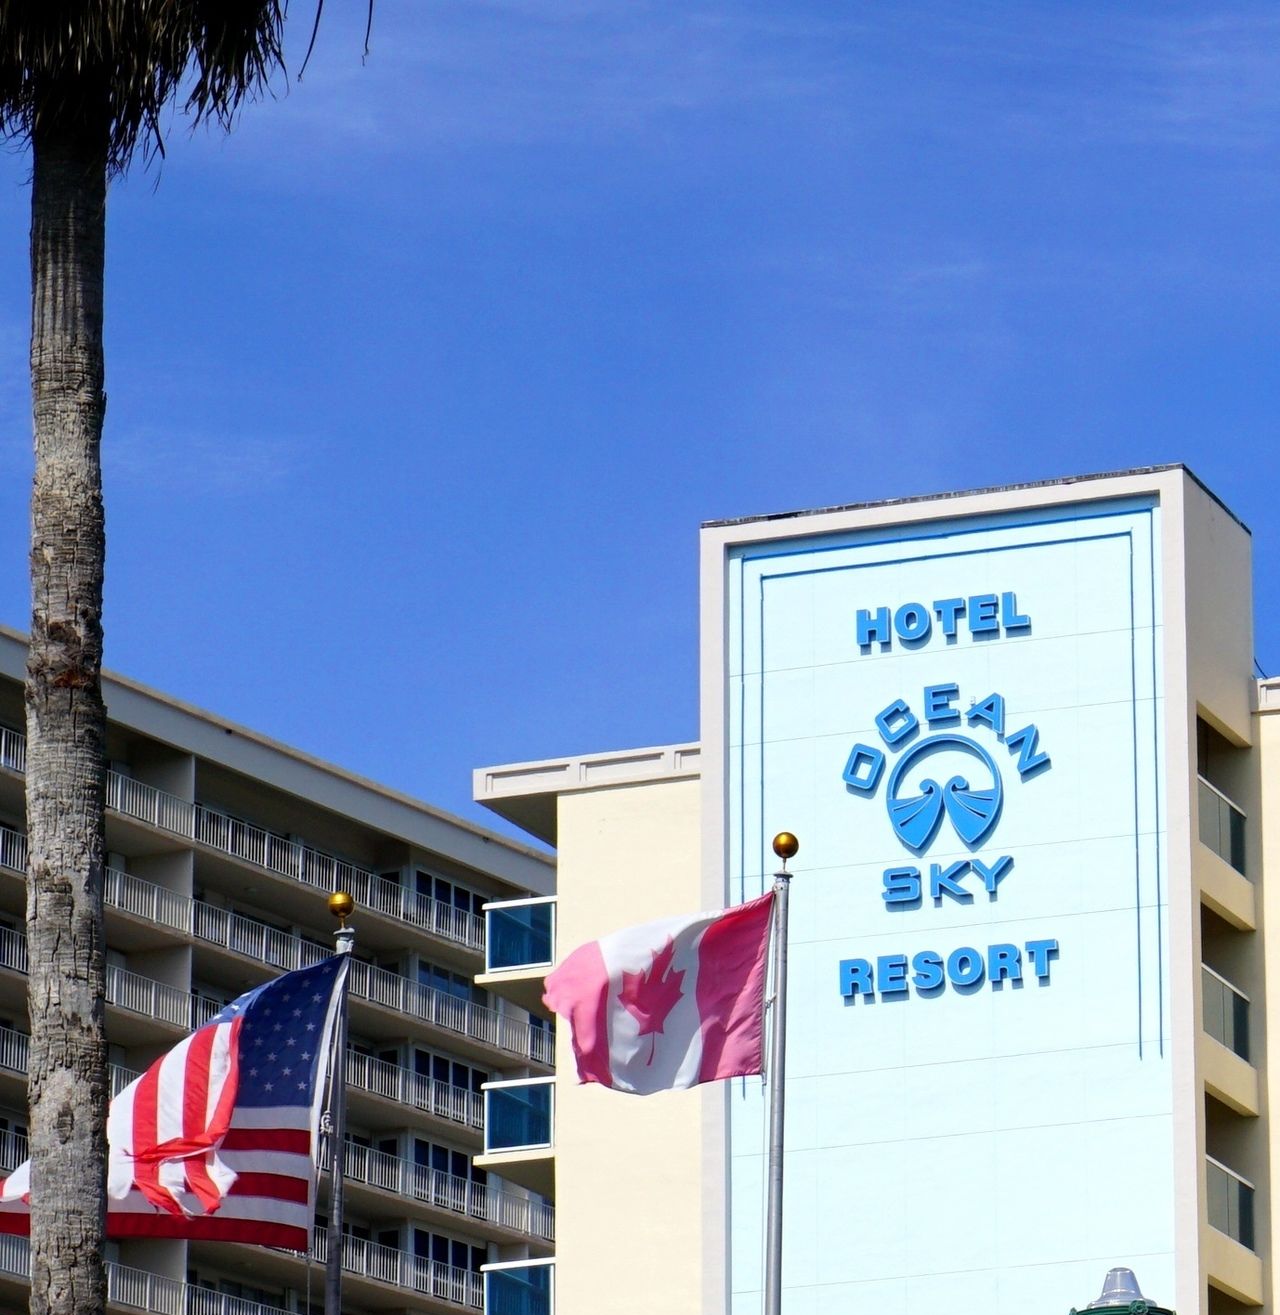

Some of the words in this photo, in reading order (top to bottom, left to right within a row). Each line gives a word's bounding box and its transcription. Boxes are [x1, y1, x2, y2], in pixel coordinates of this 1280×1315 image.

[856, 592, 1031, 653] HOTEL
[842, 682, 1051, 795] OCEAN
[881, 855, 1014, 908] SKY
[839, 938, 1060, 1003] RESORT
